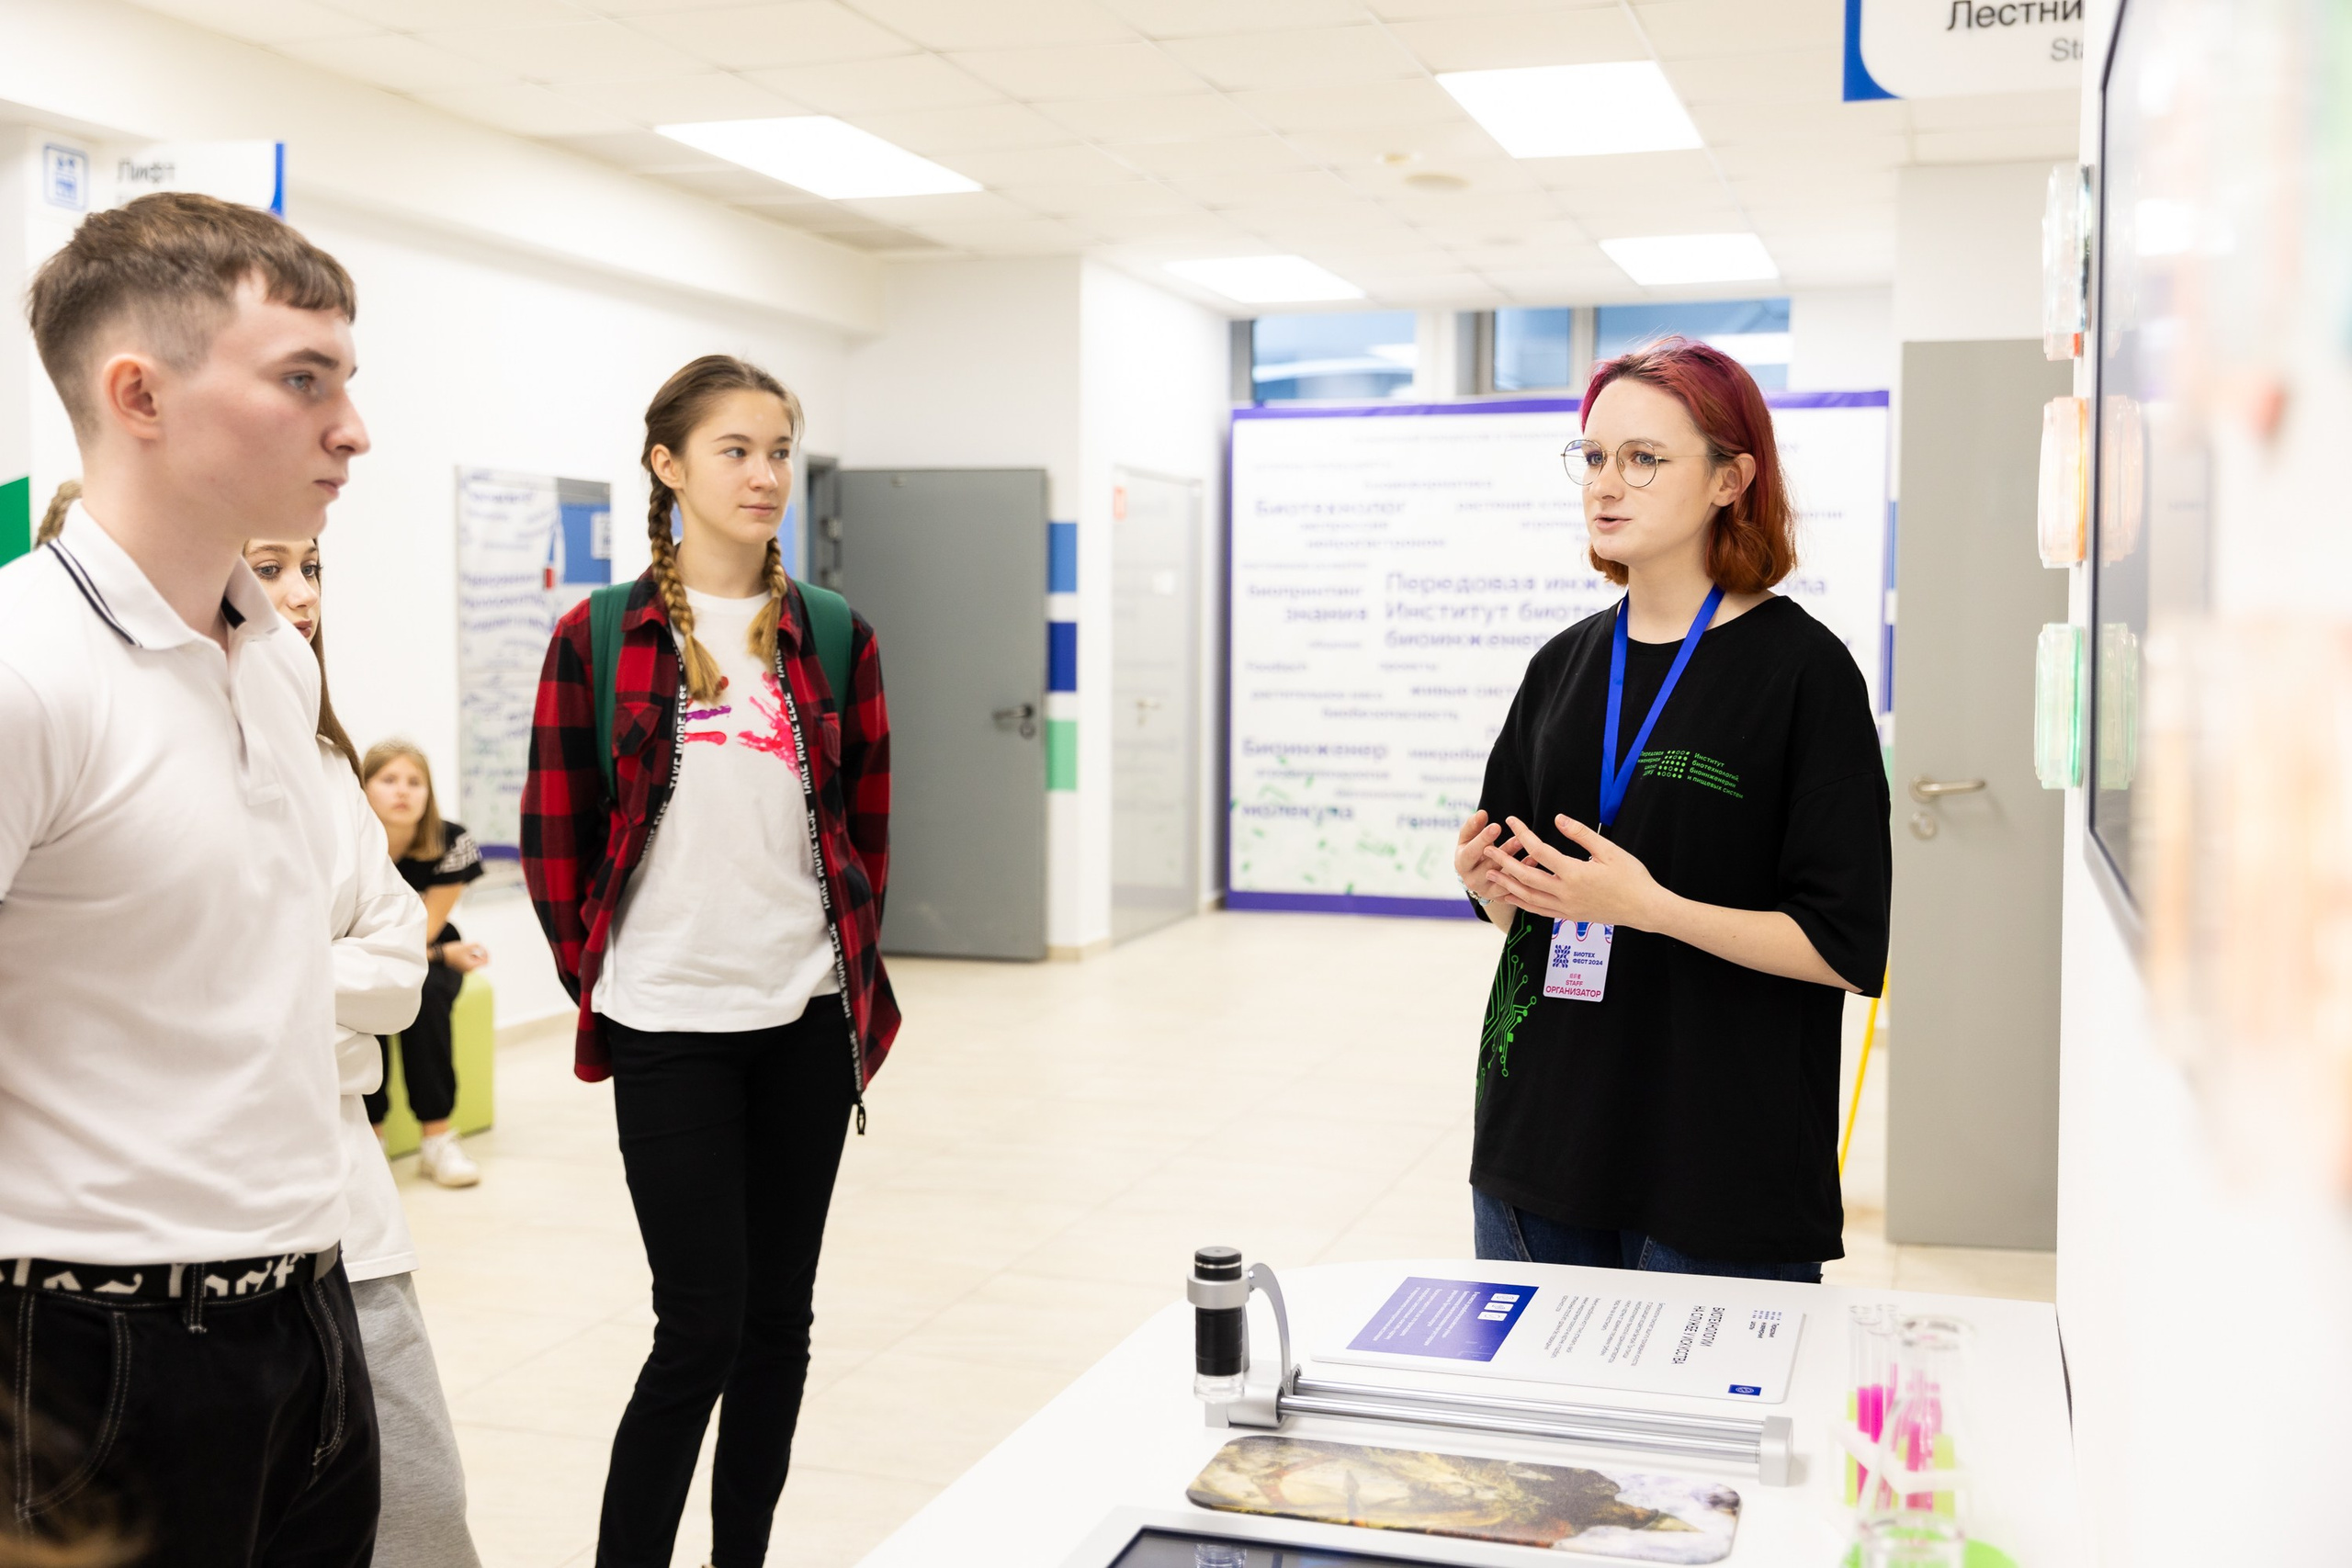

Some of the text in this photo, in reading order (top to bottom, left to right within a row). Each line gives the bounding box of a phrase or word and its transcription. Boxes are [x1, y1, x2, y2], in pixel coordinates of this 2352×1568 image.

[1947, 0, 2083, 30] Лестни
[2051, 38, 2083, 62] St
[1385, 572, 1536, 598] Передовая
[1385, 602, 1601, 627] Институт биоте
[1385, 629, 1553, 649] биоинженер
[1694, 752, 1725, 768] Институт
[1689, 767, 1736, 787] биоинженерии
[1692, 776, 1723, 791] пищевых
[1723, 787, 1744, 799] систем
[1545, 986, 1601, 998] ОРГАНИЗАТОР
[1684, 1313, 1703, 1331] СЛУЖБЕ
[1700, 1307, 1724, 1347] БИОТЕХНОЛОГИИ
[1671, 1337, 1693, 1364] ИСКУССТВА
